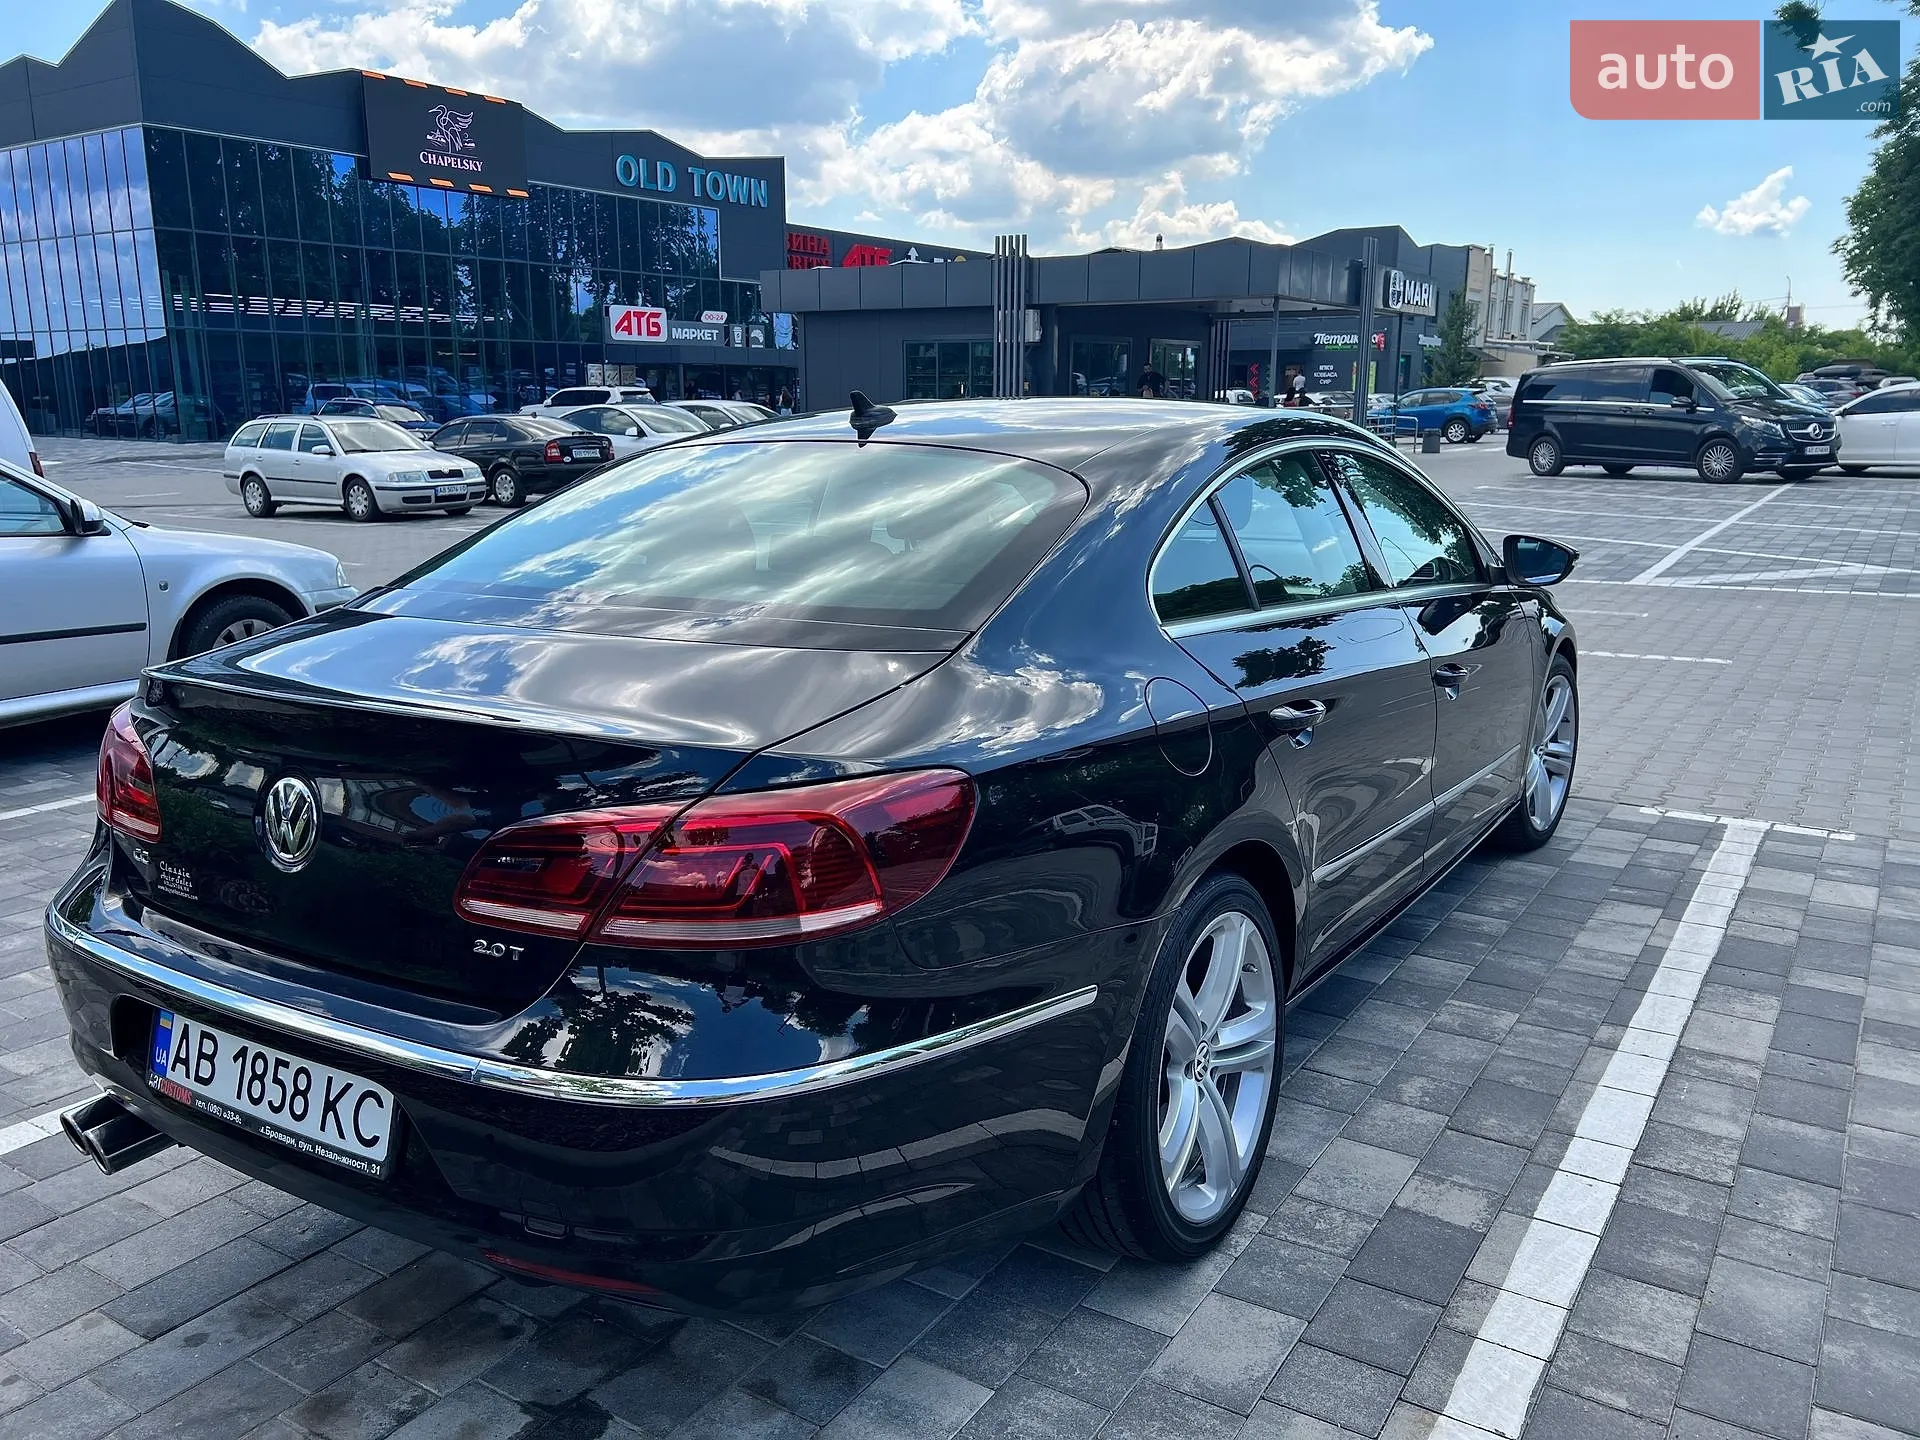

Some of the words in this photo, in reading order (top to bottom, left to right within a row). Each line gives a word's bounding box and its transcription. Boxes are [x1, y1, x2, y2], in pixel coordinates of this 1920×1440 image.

[616, 154, 677, 193] OLD
[687, 166, 768, 208] TOWN
[1404, 279, 1433, 307] MARI
[614, 310, 663, 337] АТБ
[671, 327, 720, 341] МАРКЕТ
[156, 1047, 167, 1066] UA
[170, 1022, 219, 1087] AB
[232, 1045, 312, 1123] 1858
[319, 1075, 385, 1149] KC
[371, 1163, 381, 1175] 31
